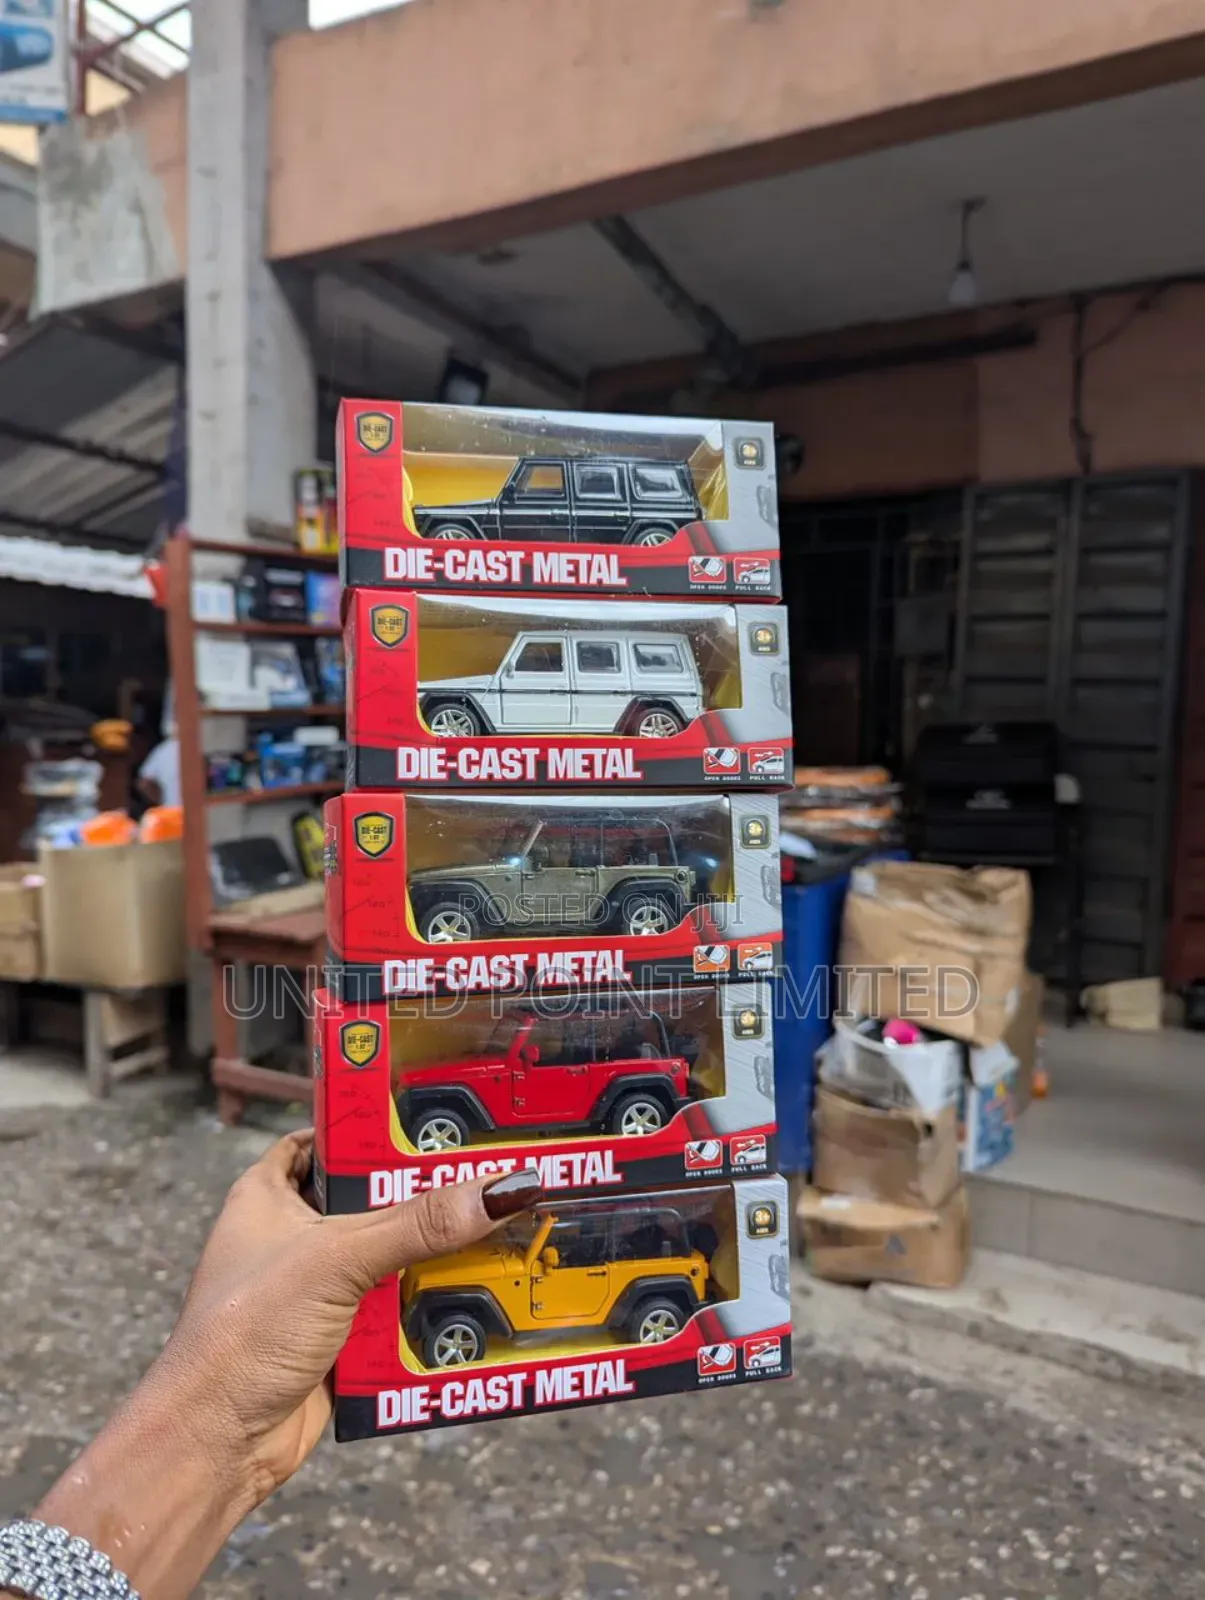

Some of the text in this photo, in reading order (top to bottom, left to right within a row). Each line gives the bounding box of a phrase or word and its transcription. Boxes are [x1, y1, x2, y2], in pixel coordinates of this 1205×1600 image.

[384, 547, 627, 585] DIE-CAST METAL
[398, 746, 642, 780] DIE-CAST METAL
[384, 949, 632, 995] DIE-CAST METAL
[525, 1149, 623, 1189] METAL
[377, 1358, 634, 1429] DIE-CAST METAL
